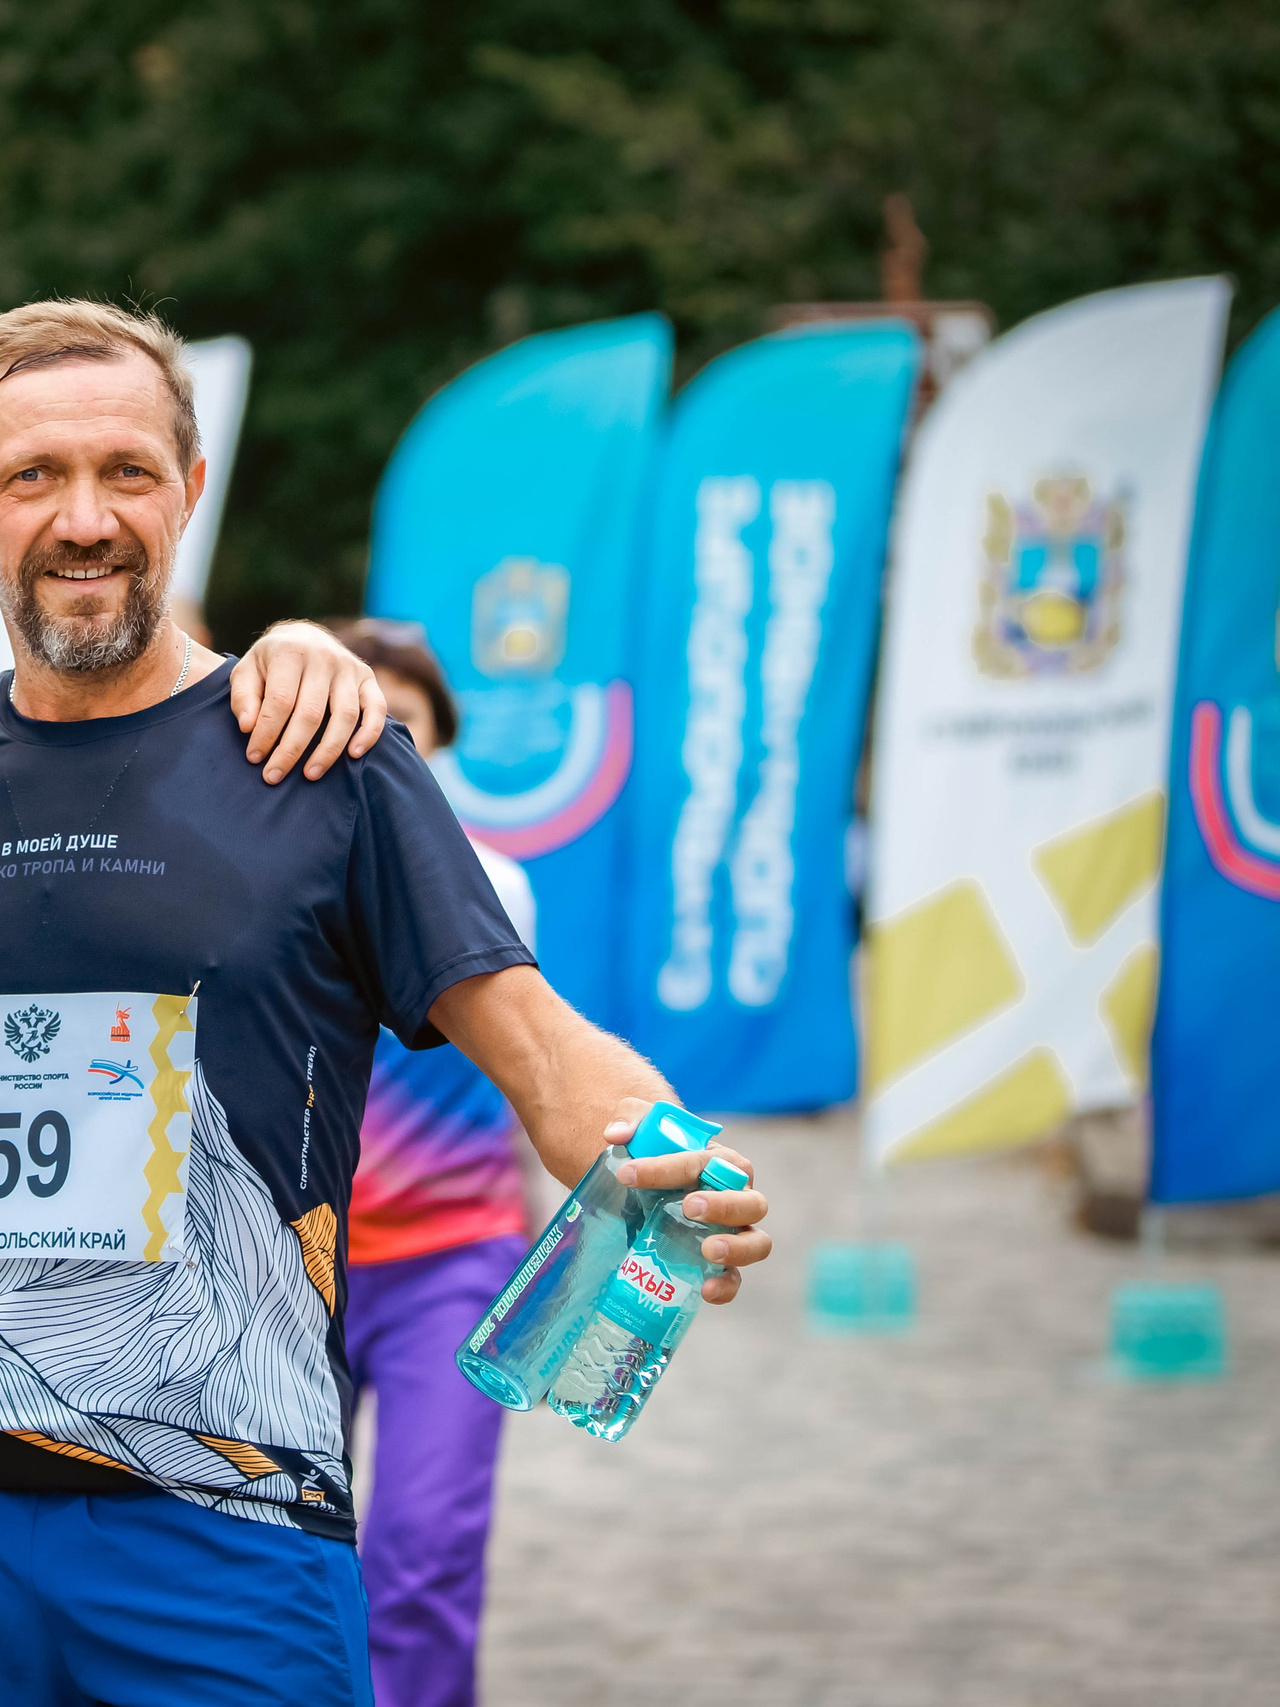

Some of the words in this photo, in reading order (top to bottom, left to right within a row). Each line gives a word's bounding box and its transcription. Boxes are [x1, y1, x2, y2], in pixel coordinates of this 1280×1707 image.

[1, 842, 11, 856] В
[16, 833, 61, 854] МОЕЙ
[66, 834, 118, 852] ДУШЕ
[22, 859, 76, 877] ТРОПА
[81, 857, 94, 872] И
[99, 858, 165, 876] КАМНИ
[43, 1073, 69, 1081] СПОРТА
[300, 1108, 311, 1190] СПОРТМАСТЕР
[306, 1045, 317, 1082] ТРЕЙЛ
[79, 1229, 126, 1251] КРАЙ
[492, 1223, 564, 1322] ЖЕЛЕЗНОВОДСК
[619, 1257, 675, 1302] АРХЫЗ
[637, 1292, 664, 1318] VITA
[469, 1316, 496, 1354] 2025
